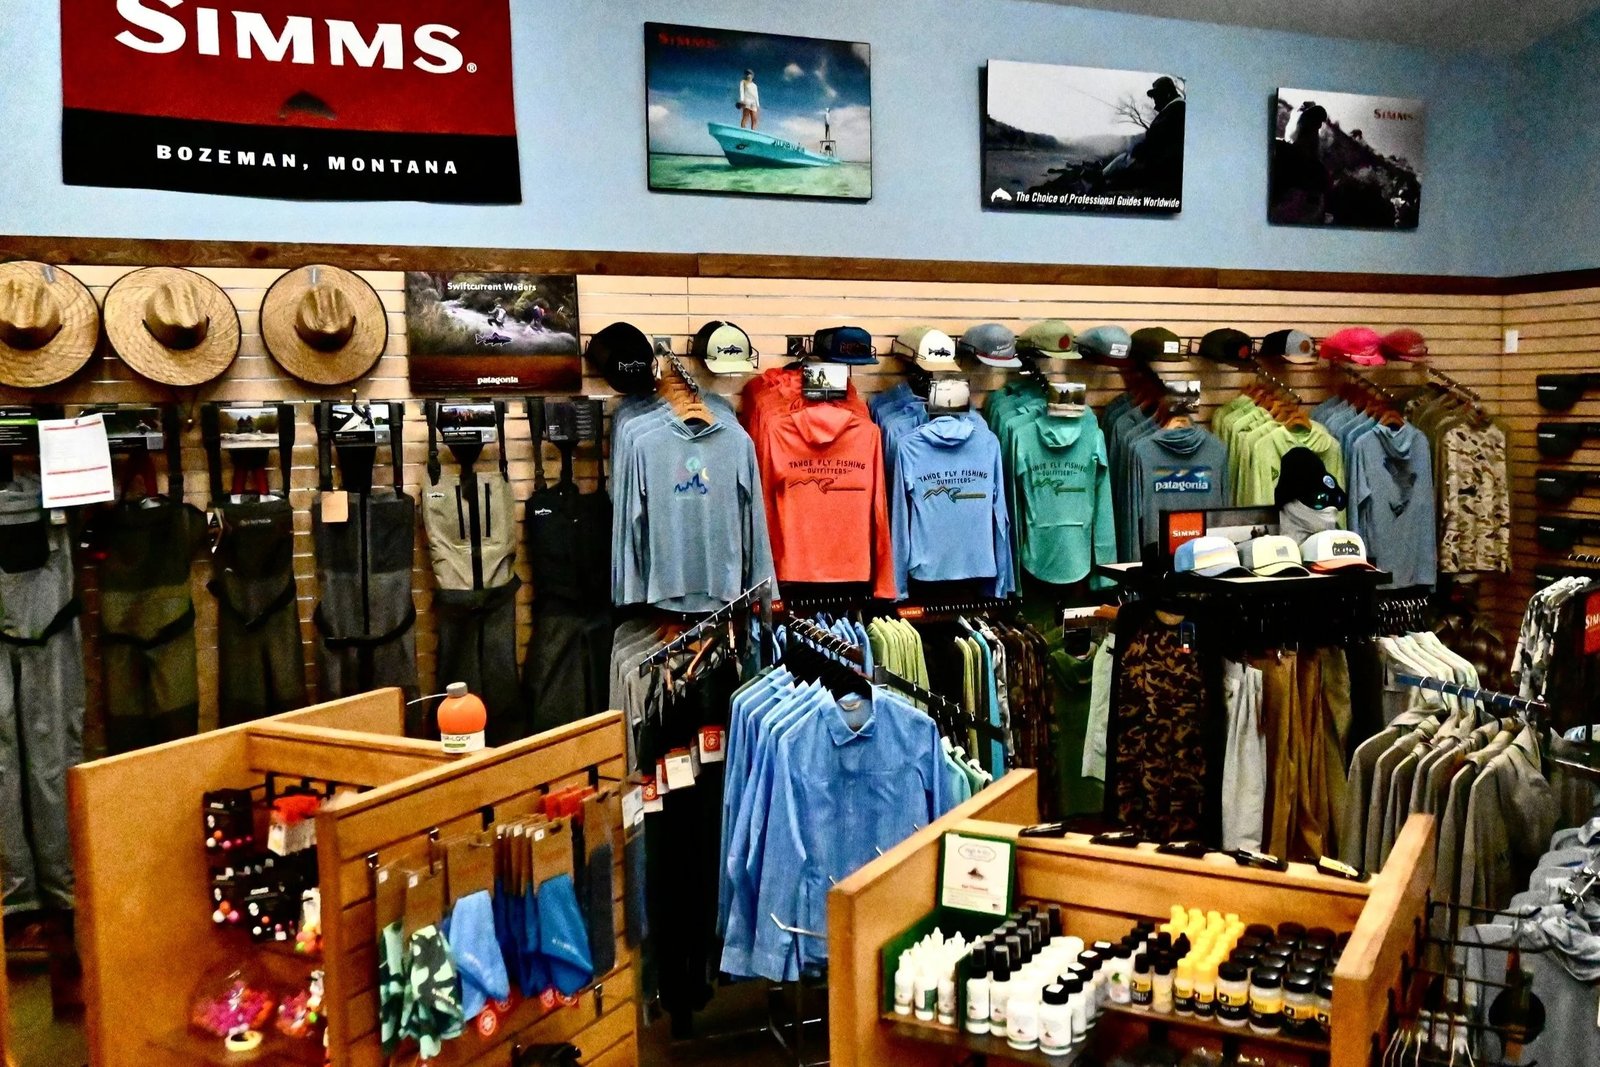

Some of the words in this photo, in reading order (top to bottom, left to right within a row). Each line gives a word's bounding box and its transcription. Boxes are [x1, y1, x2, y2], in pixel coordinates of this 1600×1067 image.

[156, 144, 310, 171] BOZEMAN,
[327, 155, 459, 175] MONTANA
[1016, 191, 1030, 203] The
[1031, 192, 1058, 204] Choice
[1059, 193, 1069, 203] of
[1068, 193, 1116, 206] Professional
[1116, 196, 1142, 207] Guides
[1143, 197, 1180, 209] Worldwide
[447, 282, 502, 291] Swiftcurrent
[503, 282, 537, 291] Waders
[477, 376, 519, 385] patagonia
[788, 459, 813, 469] TAHOE
[817, 459, 832, 467] FLY
[836, 459, 866, 470] FISHING
[807, 467, 847, 475] OUTFITTERS
[918, 472, 941, 483] TAHOE
[961, 469, 988, 479] FISHING
[936, 477, 971, 486] OUTFITTERS
[1155, 479, 1209, 492] patagonia
[1172, 529, 1201, 538] SIMMS
[1584, 613, 1600, 630] SIM
